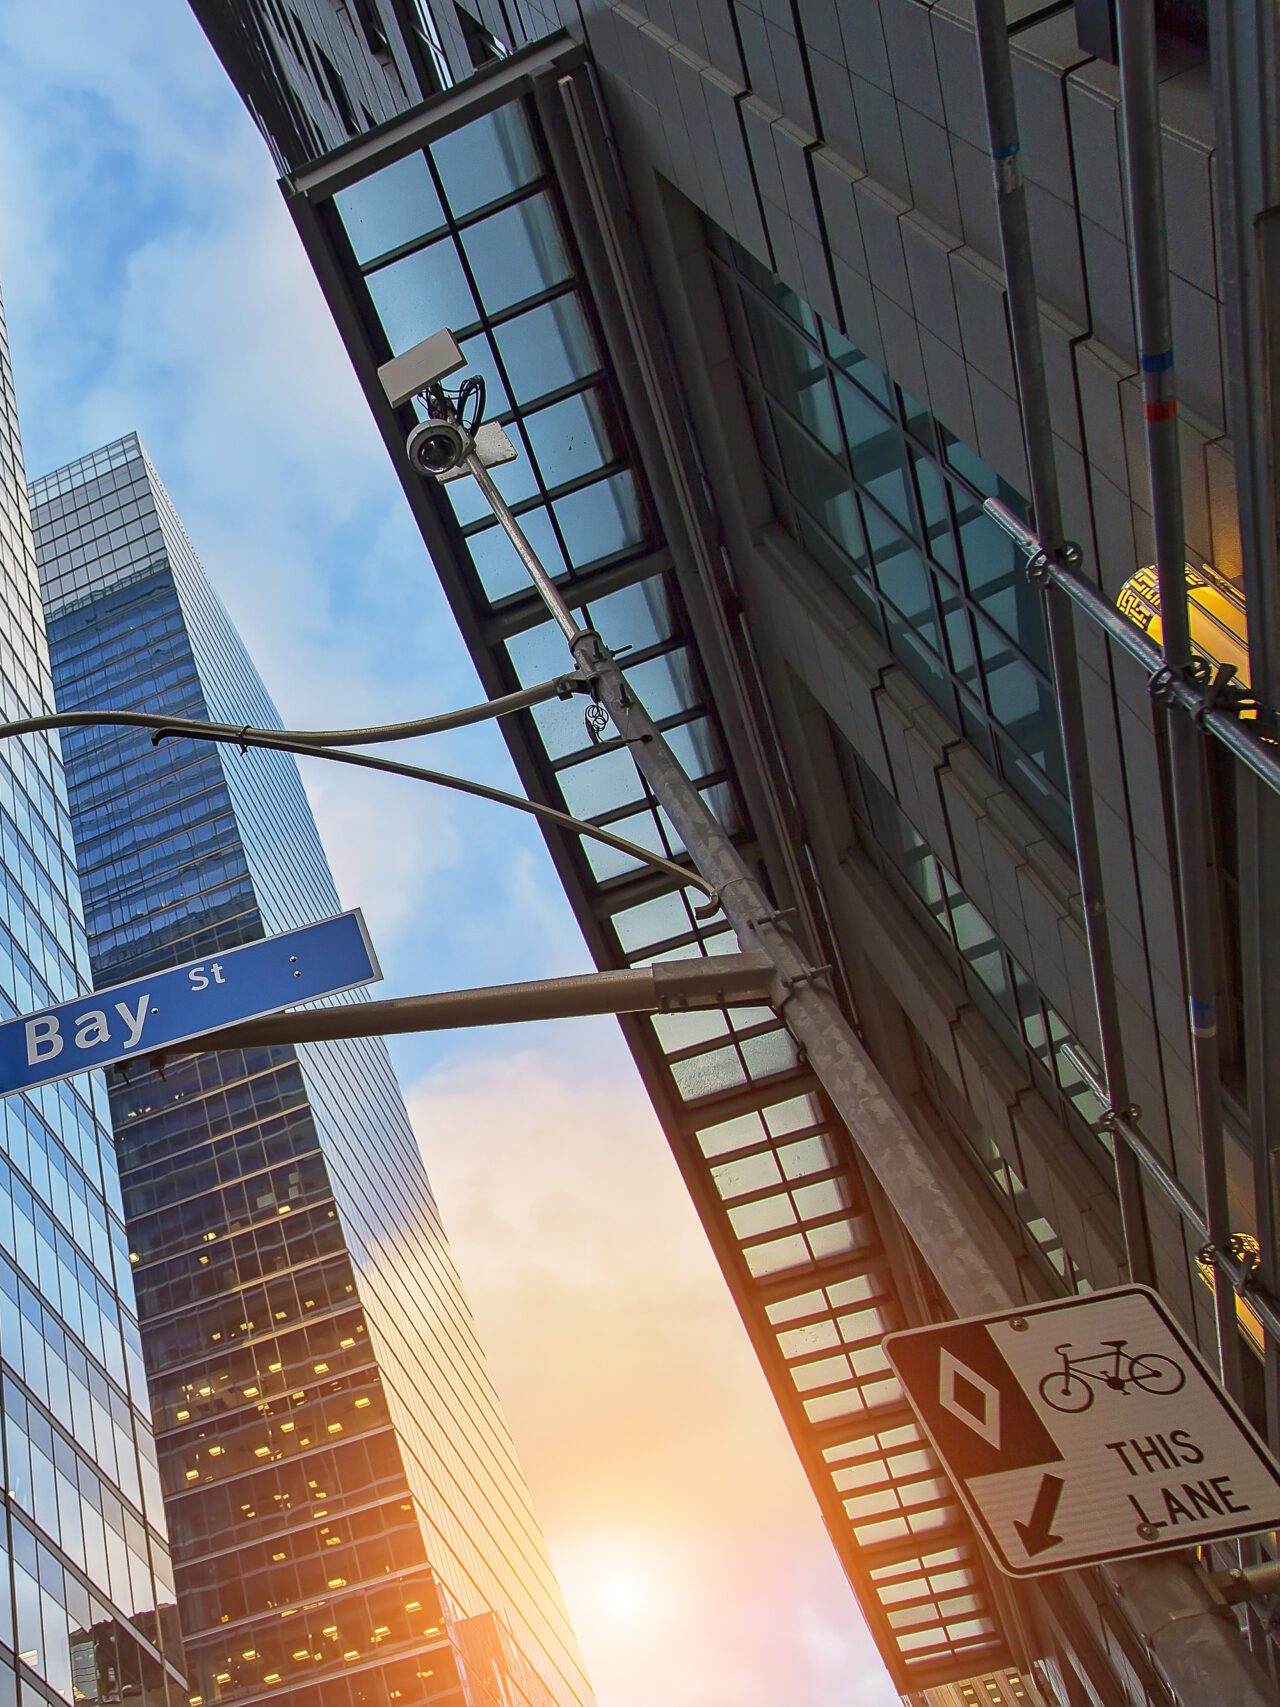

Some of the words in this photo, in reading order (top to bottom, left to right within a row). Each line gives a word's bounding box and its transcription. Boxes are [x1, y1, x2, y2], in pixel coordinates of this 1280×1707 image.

[25, 994, 150, 1066] Bay
[188, 962, 226, 991] St
[1105, 1429, 1205, 1476] THIS
[1127, 1476, 1251, 1529] LANE
